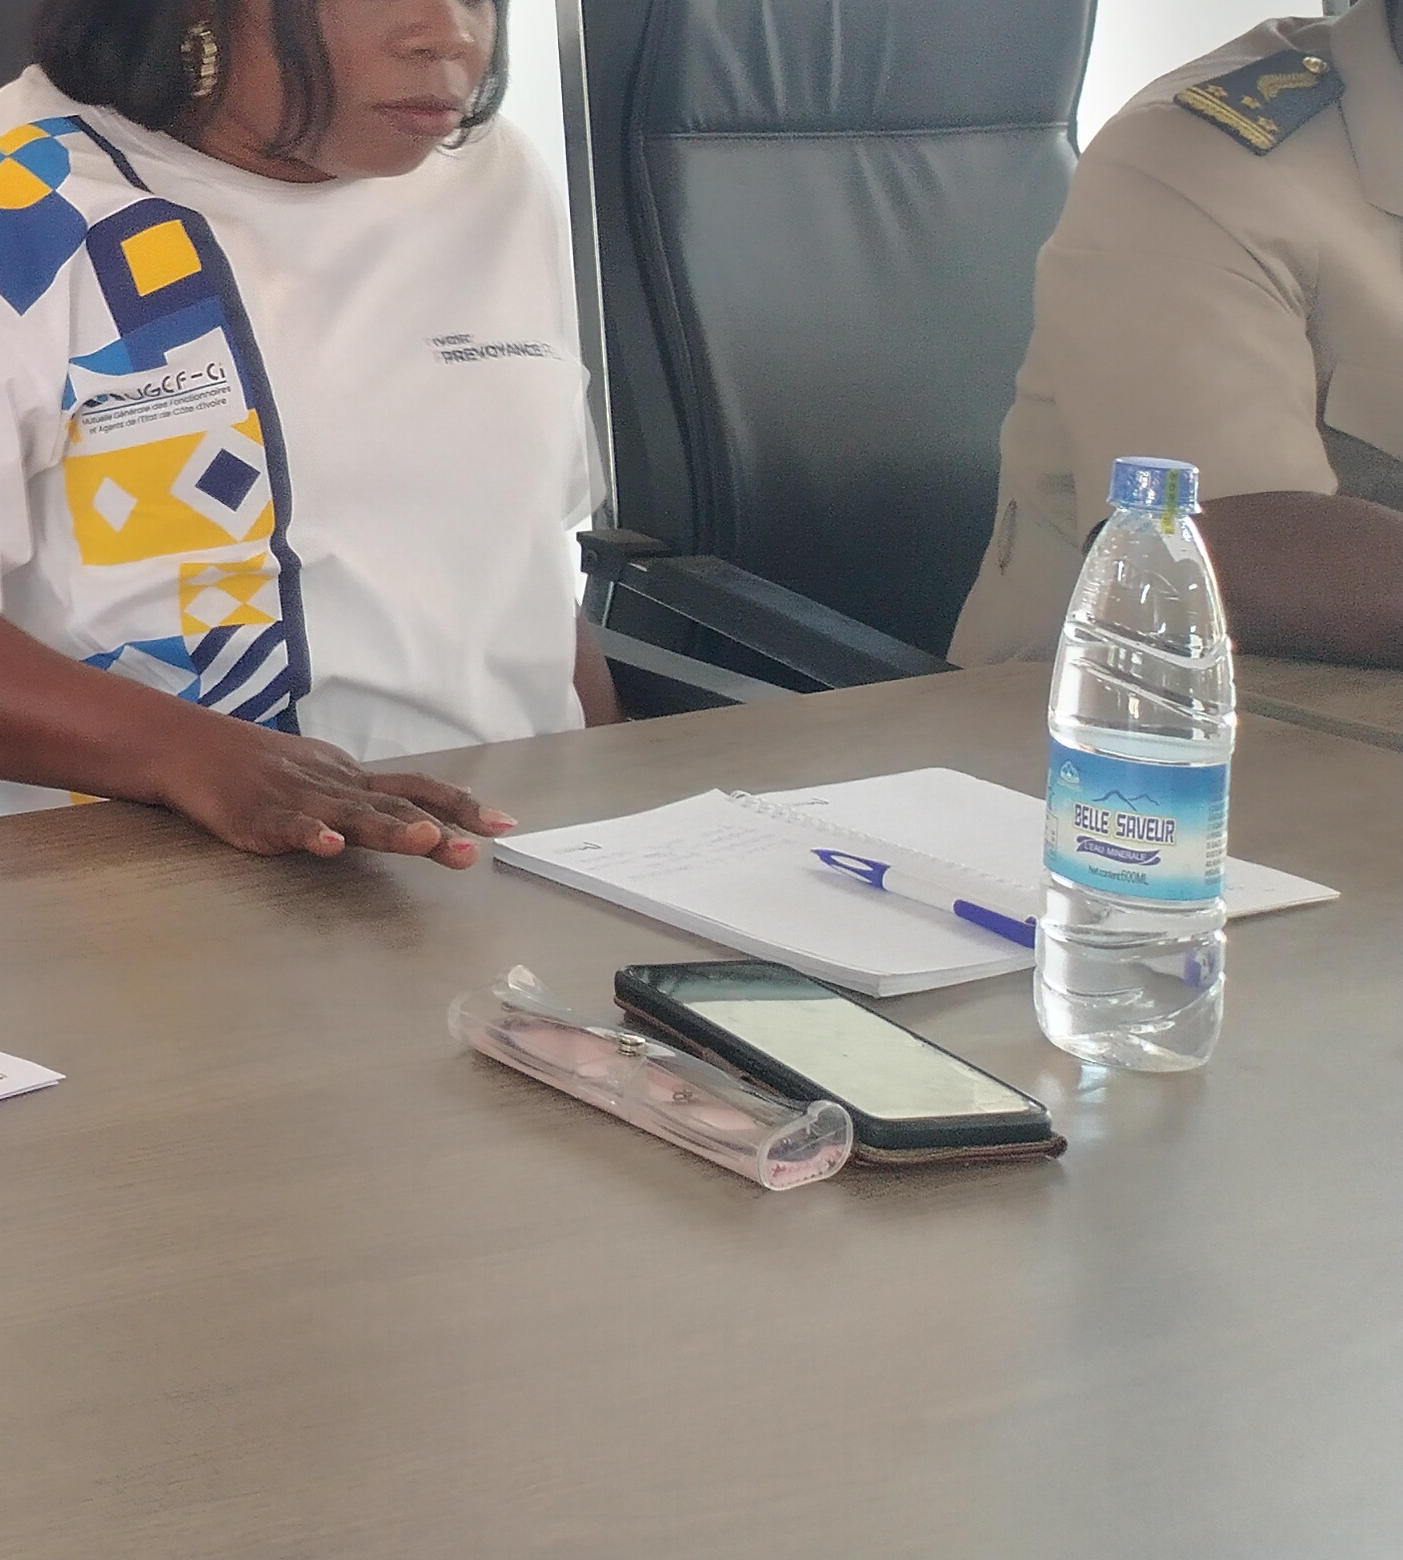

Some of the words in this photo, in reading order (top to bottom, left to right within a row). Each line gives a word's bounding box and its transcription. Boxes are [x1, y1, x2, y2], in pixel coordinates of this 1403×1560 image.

[1074, 803, 1110, 834] BELLE
[1115, 813, 1176, 844] SAVEUR
[1106, 847, 1148, 861] MINERALE
